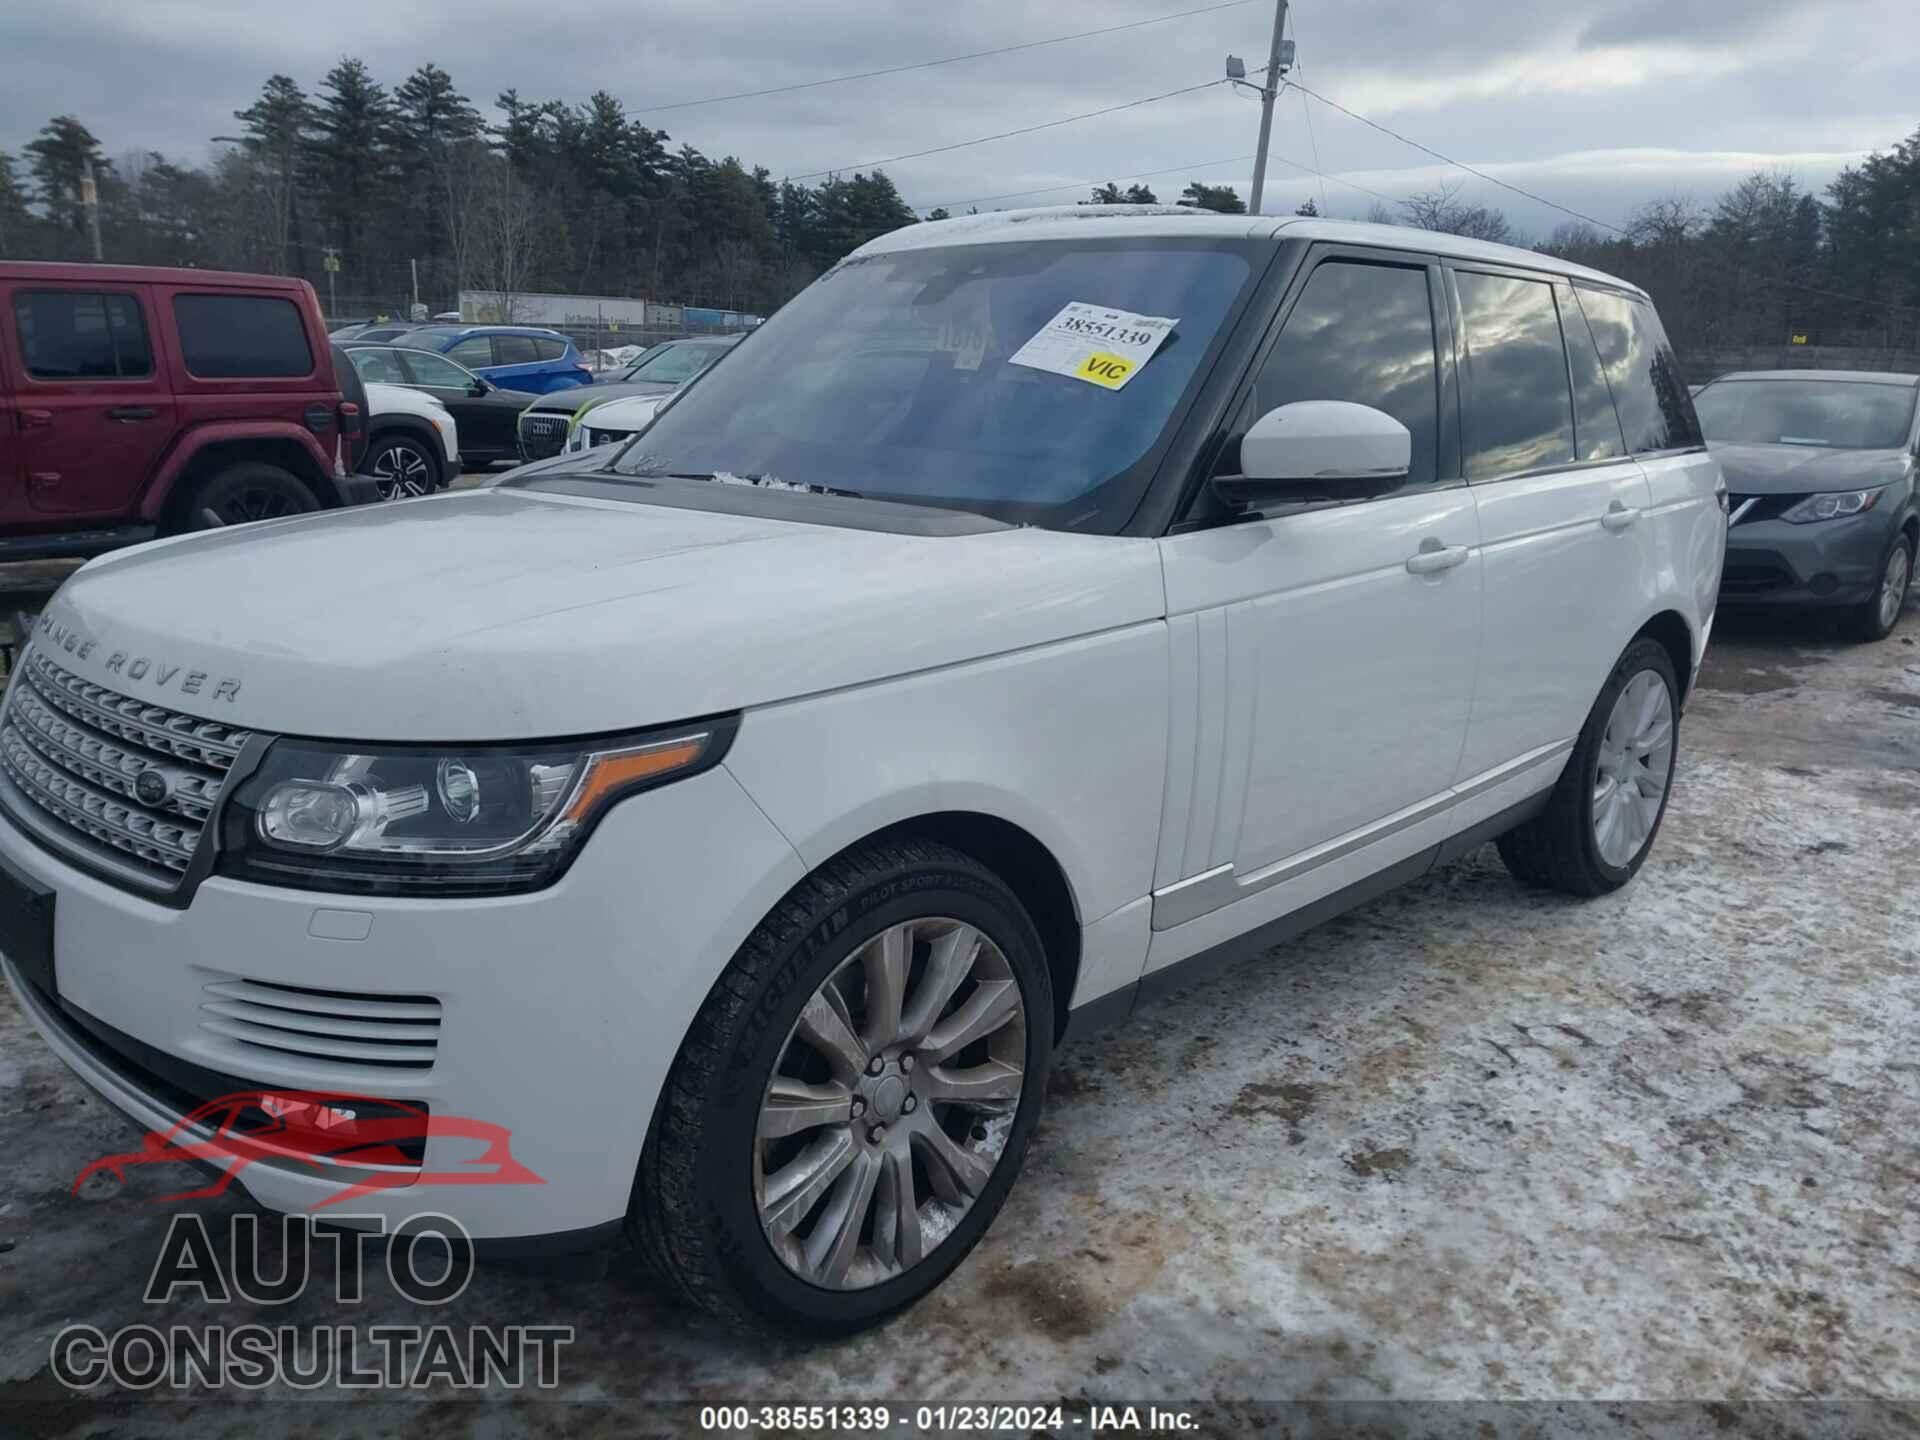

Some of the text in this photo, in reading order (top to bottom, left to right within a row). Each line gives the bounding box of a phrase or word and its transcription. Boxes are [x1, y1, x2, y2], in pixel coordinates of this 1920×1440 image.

[1057, 317, 1152, 345] 38551339
[1086, 356, 1127, 380] VIC
[41, 616, 242, 703] ANGE ROVER
